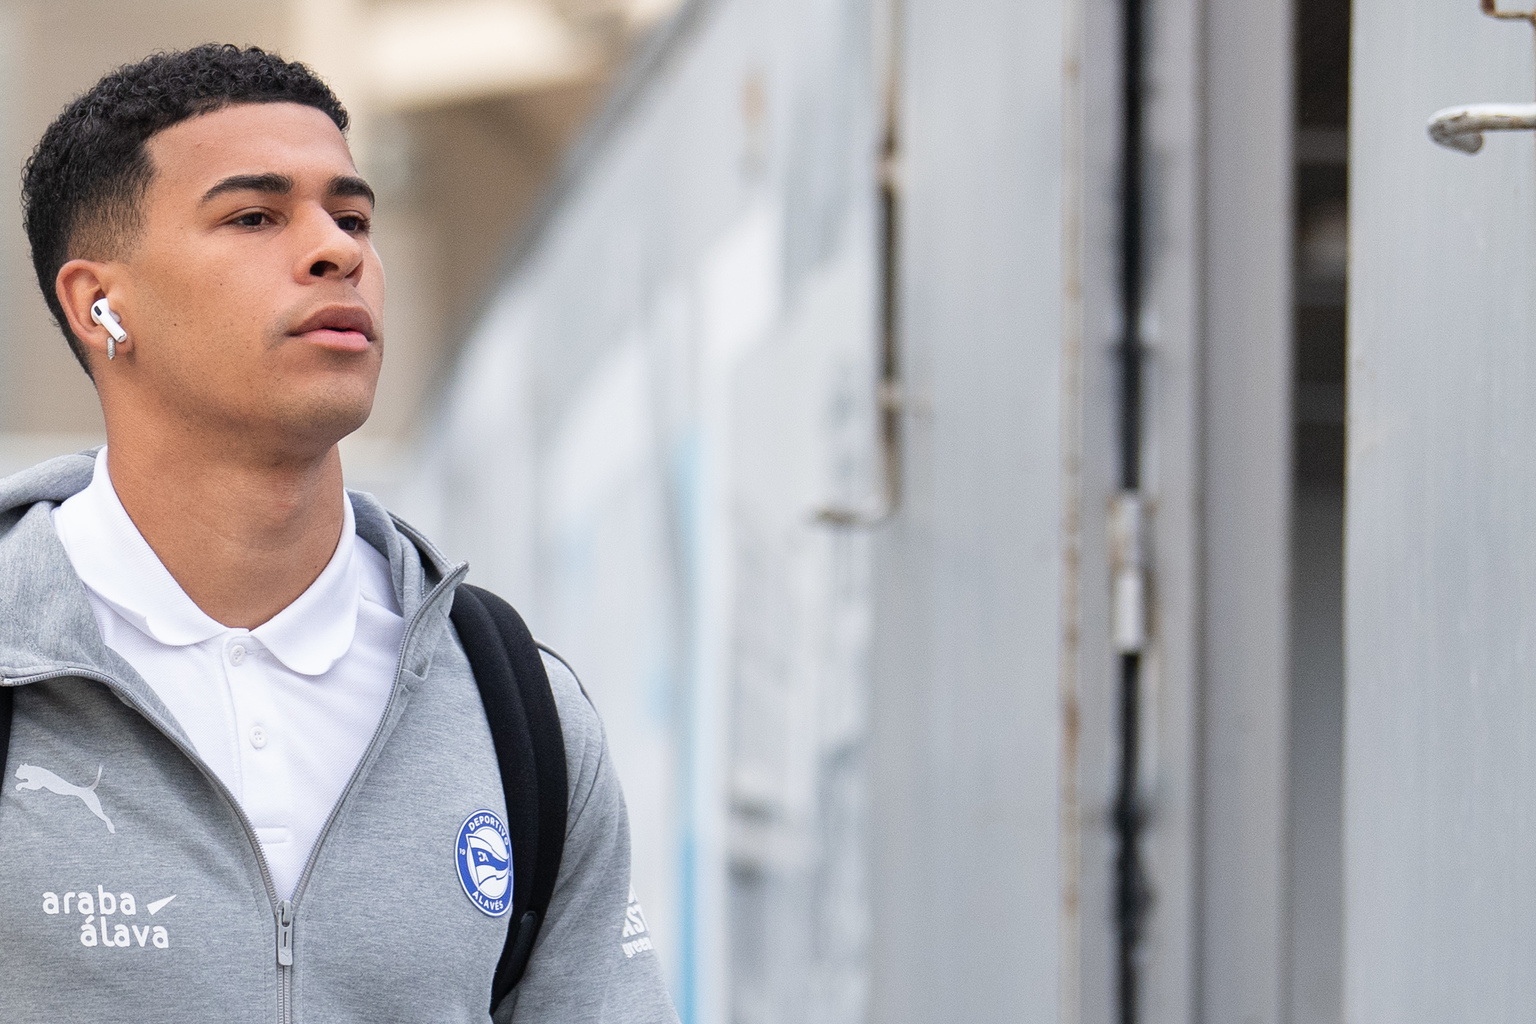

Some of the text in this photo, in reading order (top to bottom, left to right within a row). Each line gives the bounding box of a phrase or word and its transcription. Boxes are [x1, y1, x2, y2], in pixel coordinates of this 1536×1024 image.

[468, 815, 509, 846] DEPORTIVO
[42, 884, 137, 915] araba
[472, 890, 504, 911] ALAVÉS
[80, 914, 169, 948] álava
